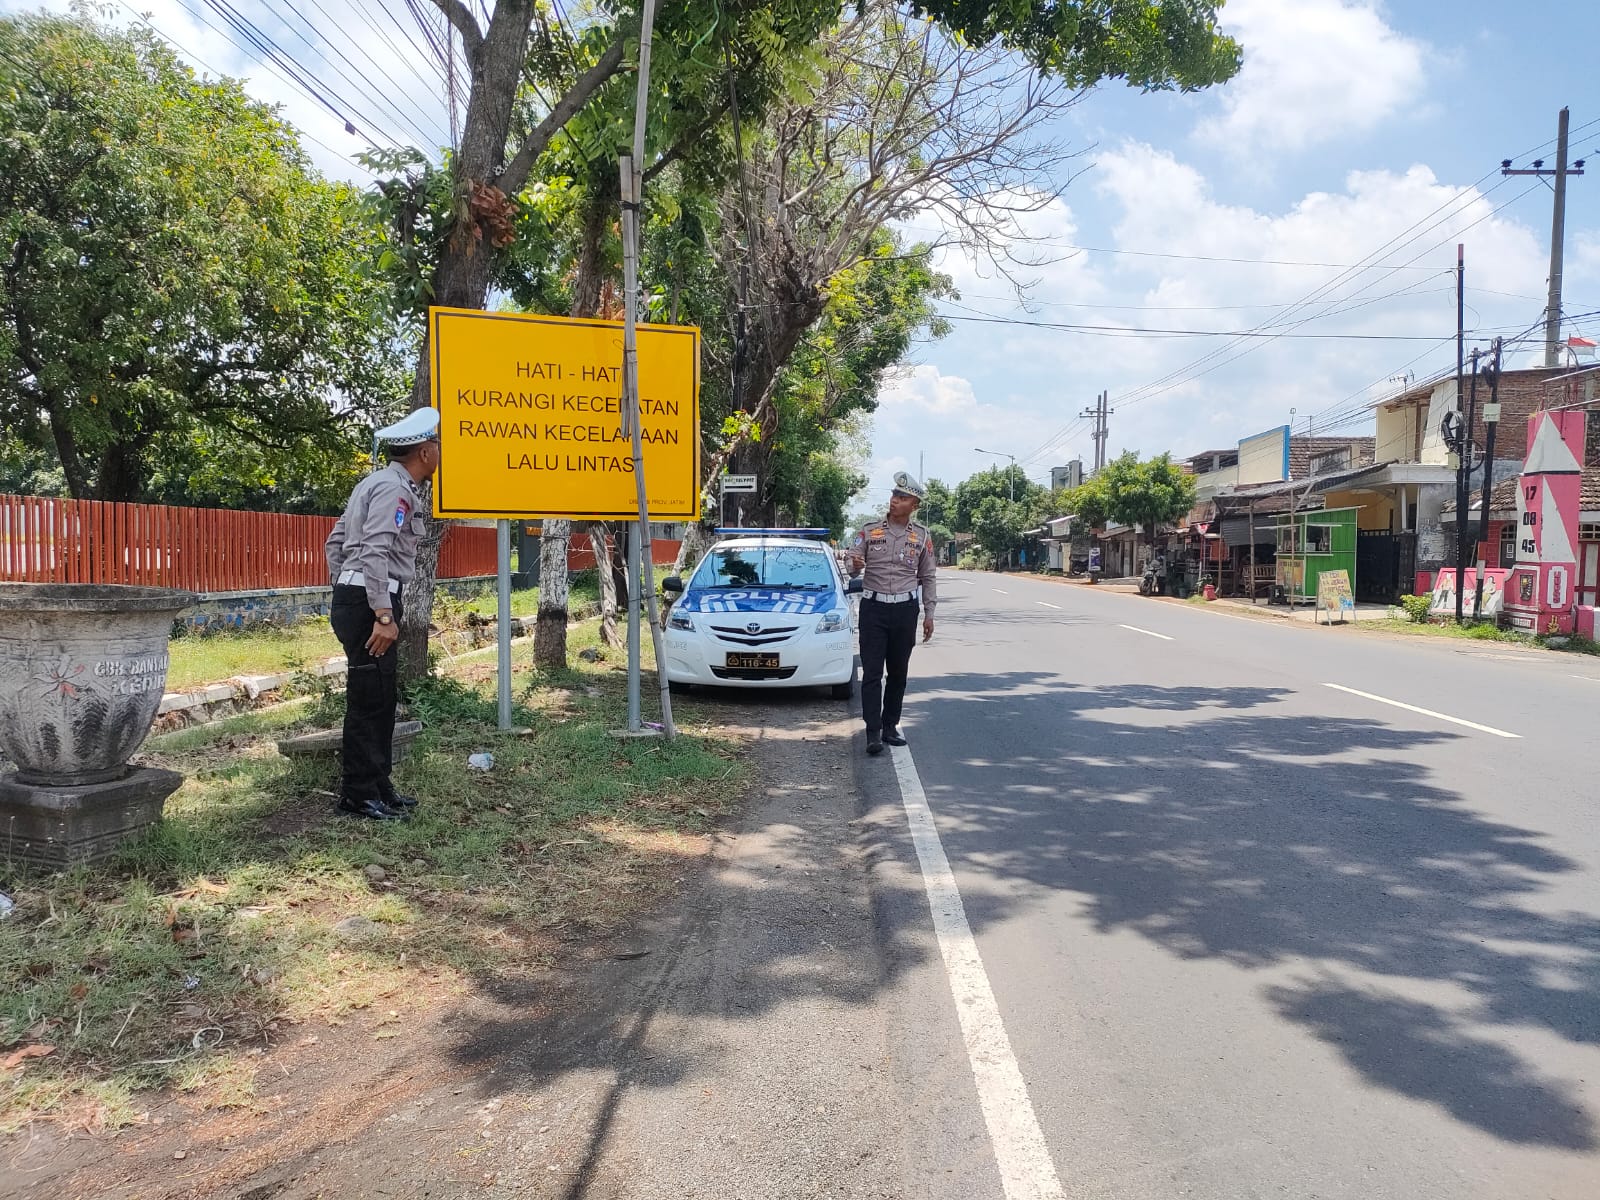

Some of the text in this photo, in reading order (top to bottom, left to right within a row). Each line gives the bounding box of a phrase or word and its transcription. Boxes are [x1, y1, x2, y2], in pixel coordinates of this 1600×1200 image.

[516, 361, 561, 380] HATI
[582, 365, 620, 382] HAT
[457, 388, 679, 416] KURANGI KECETAN
[459, 420, 537, 440] RAWAN
[507, 453, 635, 473] LALU LINTAS
[1525, 485, 1537, 500] 17
[1522, 511, 1537, 526] 08
[1521, 538, 1536, 554] 45
[700, 591, 816, 606] POLISI
